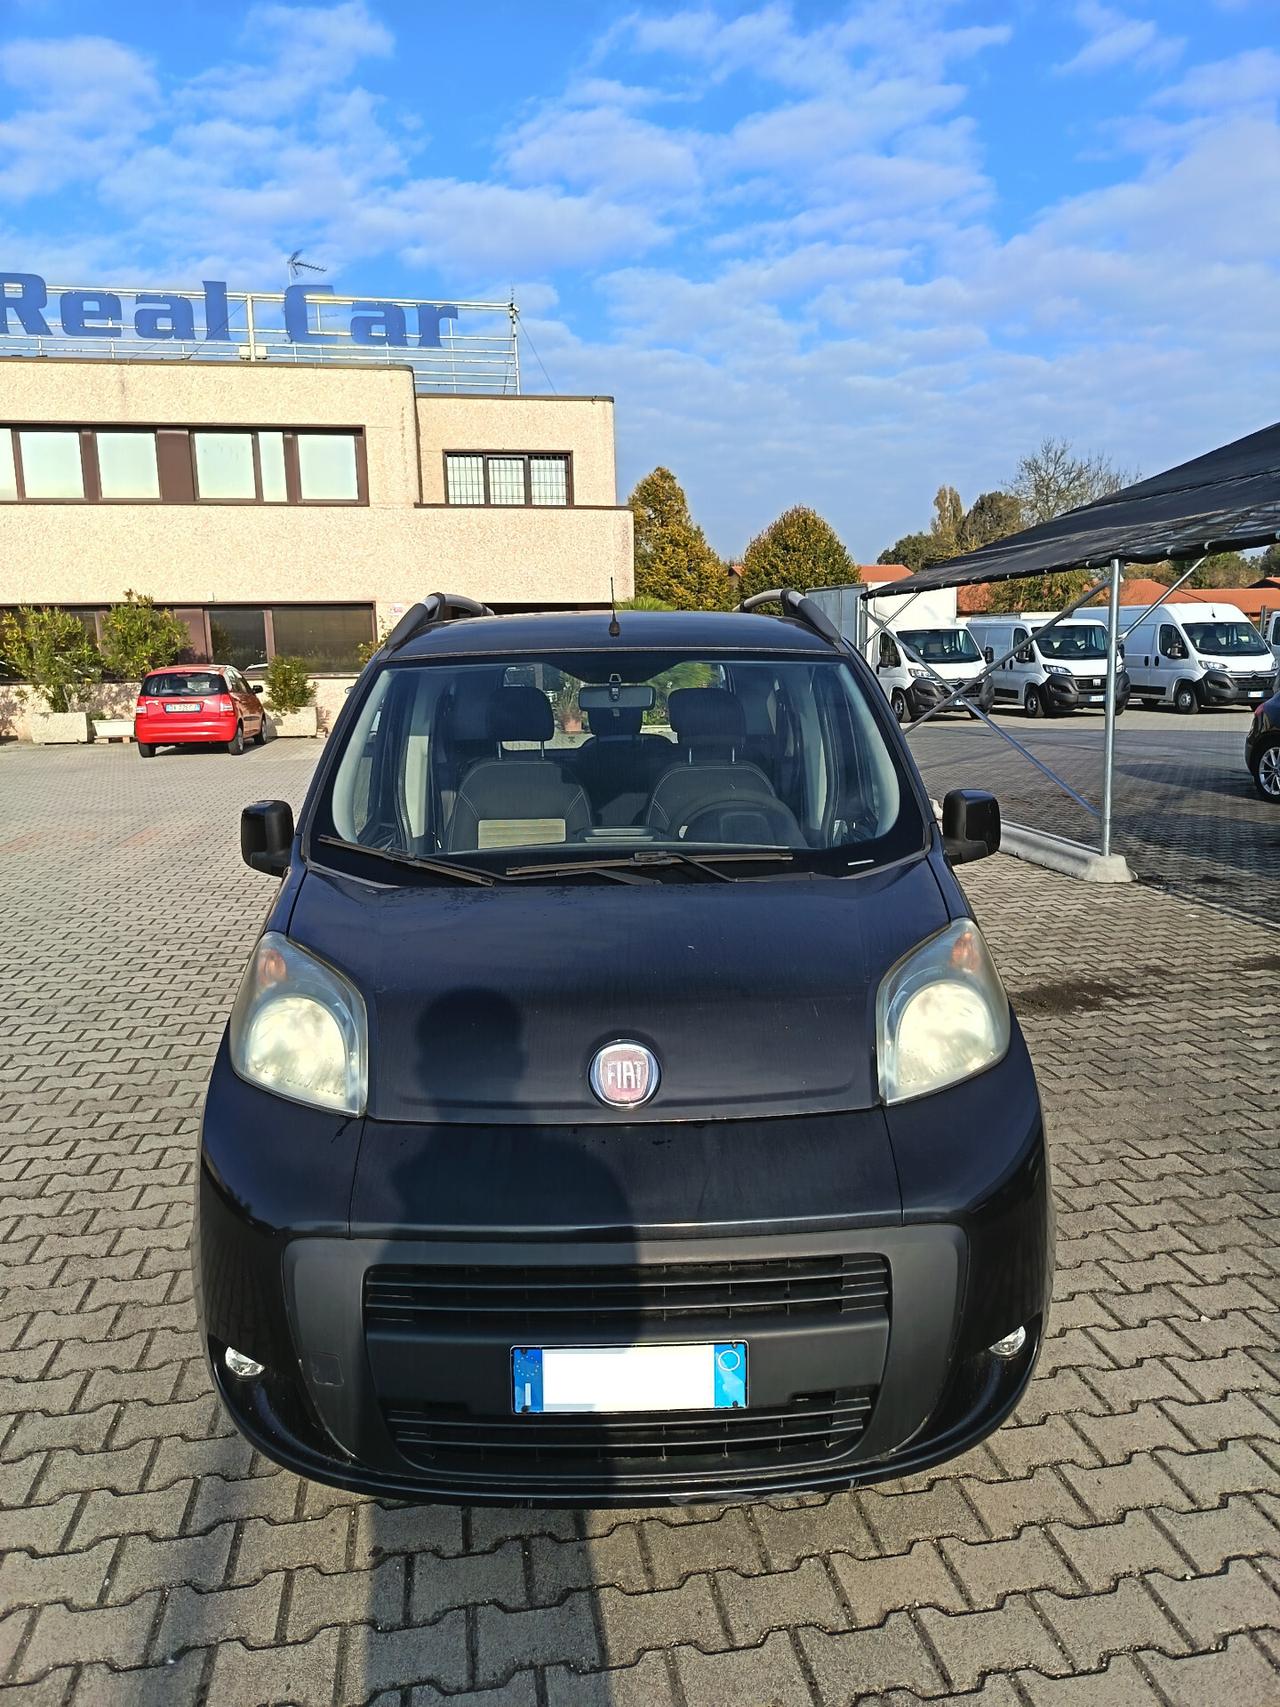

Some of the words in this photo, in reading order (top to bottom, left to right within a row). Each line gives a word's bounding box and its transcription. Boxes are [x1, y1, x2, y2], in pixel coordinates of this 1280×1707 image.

[0, 272, 231, 341] Real
[284, 284, 459, 347] Car
[606, 1060, 646, 1089] FIAT
